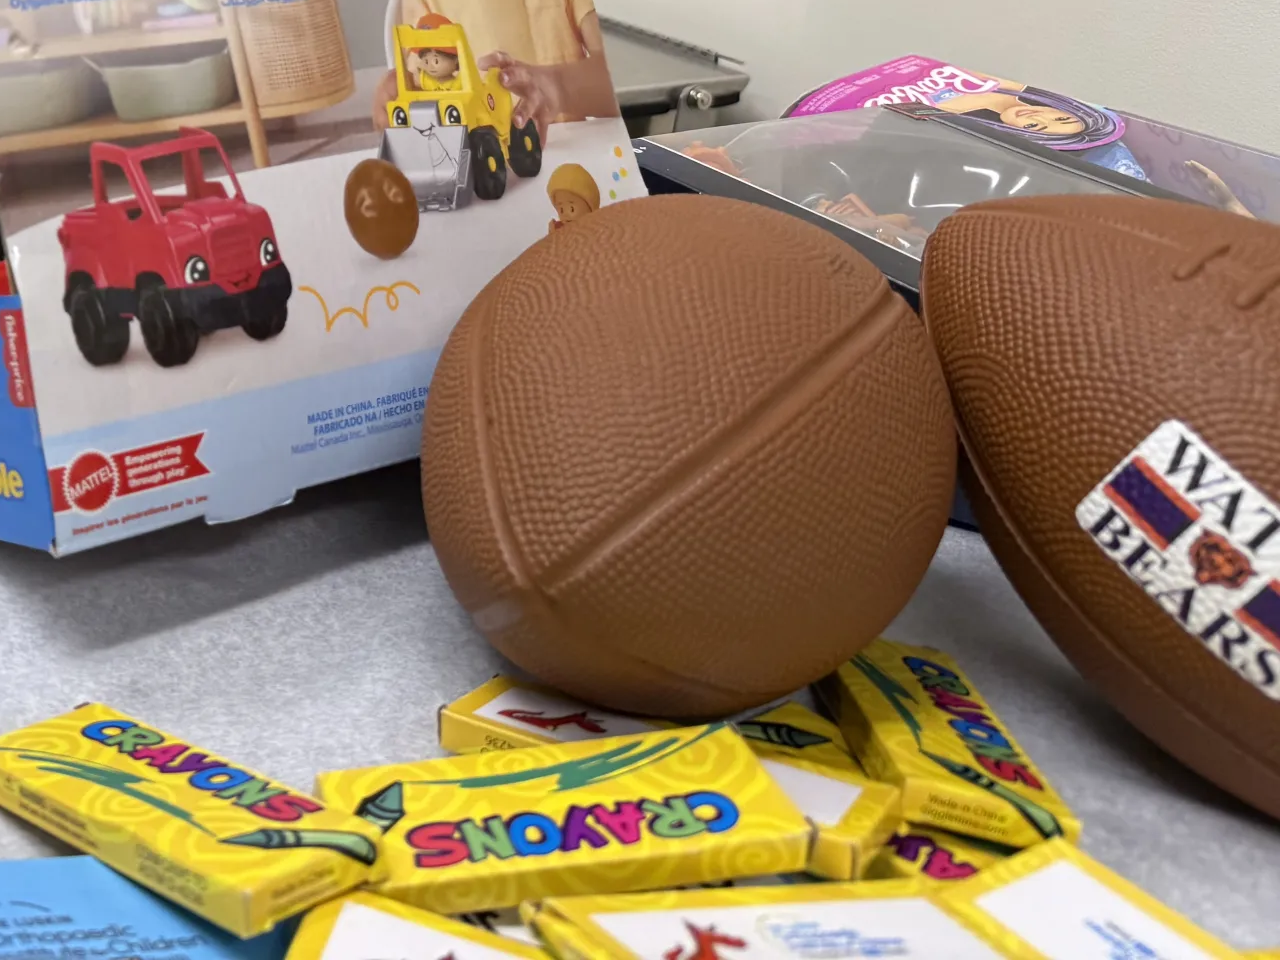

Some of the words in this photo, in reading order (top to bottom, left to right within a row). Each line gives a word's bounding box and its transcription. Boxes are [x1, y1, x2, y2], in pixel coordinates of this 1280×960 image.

[307, 408, 333, 424] MADE
[335, 406, 345, 419] IN
[376, 386, 417, 408] FABRIQUÉ
[313, 414, 363, 436] FABRICADO
[364, 411, 378, 424] NA
[383, 402, 413, 419] HECHO
[69, 466, 115, 498] MATTEL
[1091, 506, 1280, 686] BEARS
[902, 656, 1044, 791] CRAYONS
[80, 719, 326, 822] CRAYONS
[407, 790, 739, 868] CRAYONS
